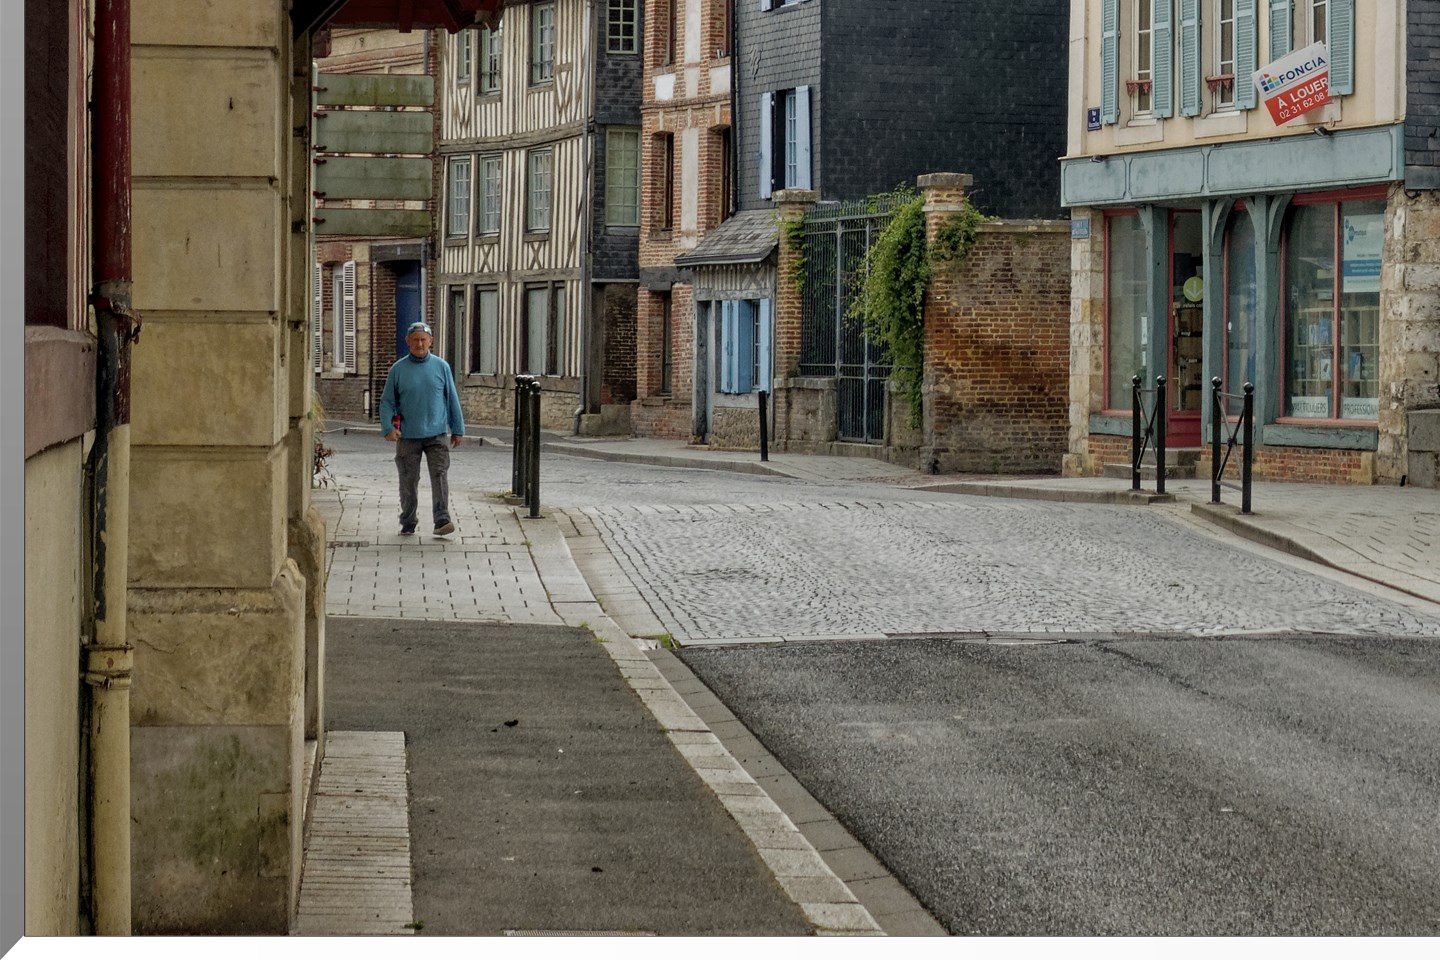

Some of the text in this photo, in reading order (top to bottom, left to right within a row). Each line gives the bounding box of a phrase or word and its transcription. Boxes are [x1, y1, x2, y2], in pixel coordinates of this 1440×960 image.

[1278, 56, 1327, 84] FONCIA
[1277, 96, 1288, 109] À
[1289, 77, 1329, 103] LOUER
[1279, 92, 1325, 119] 02 31 62 08
